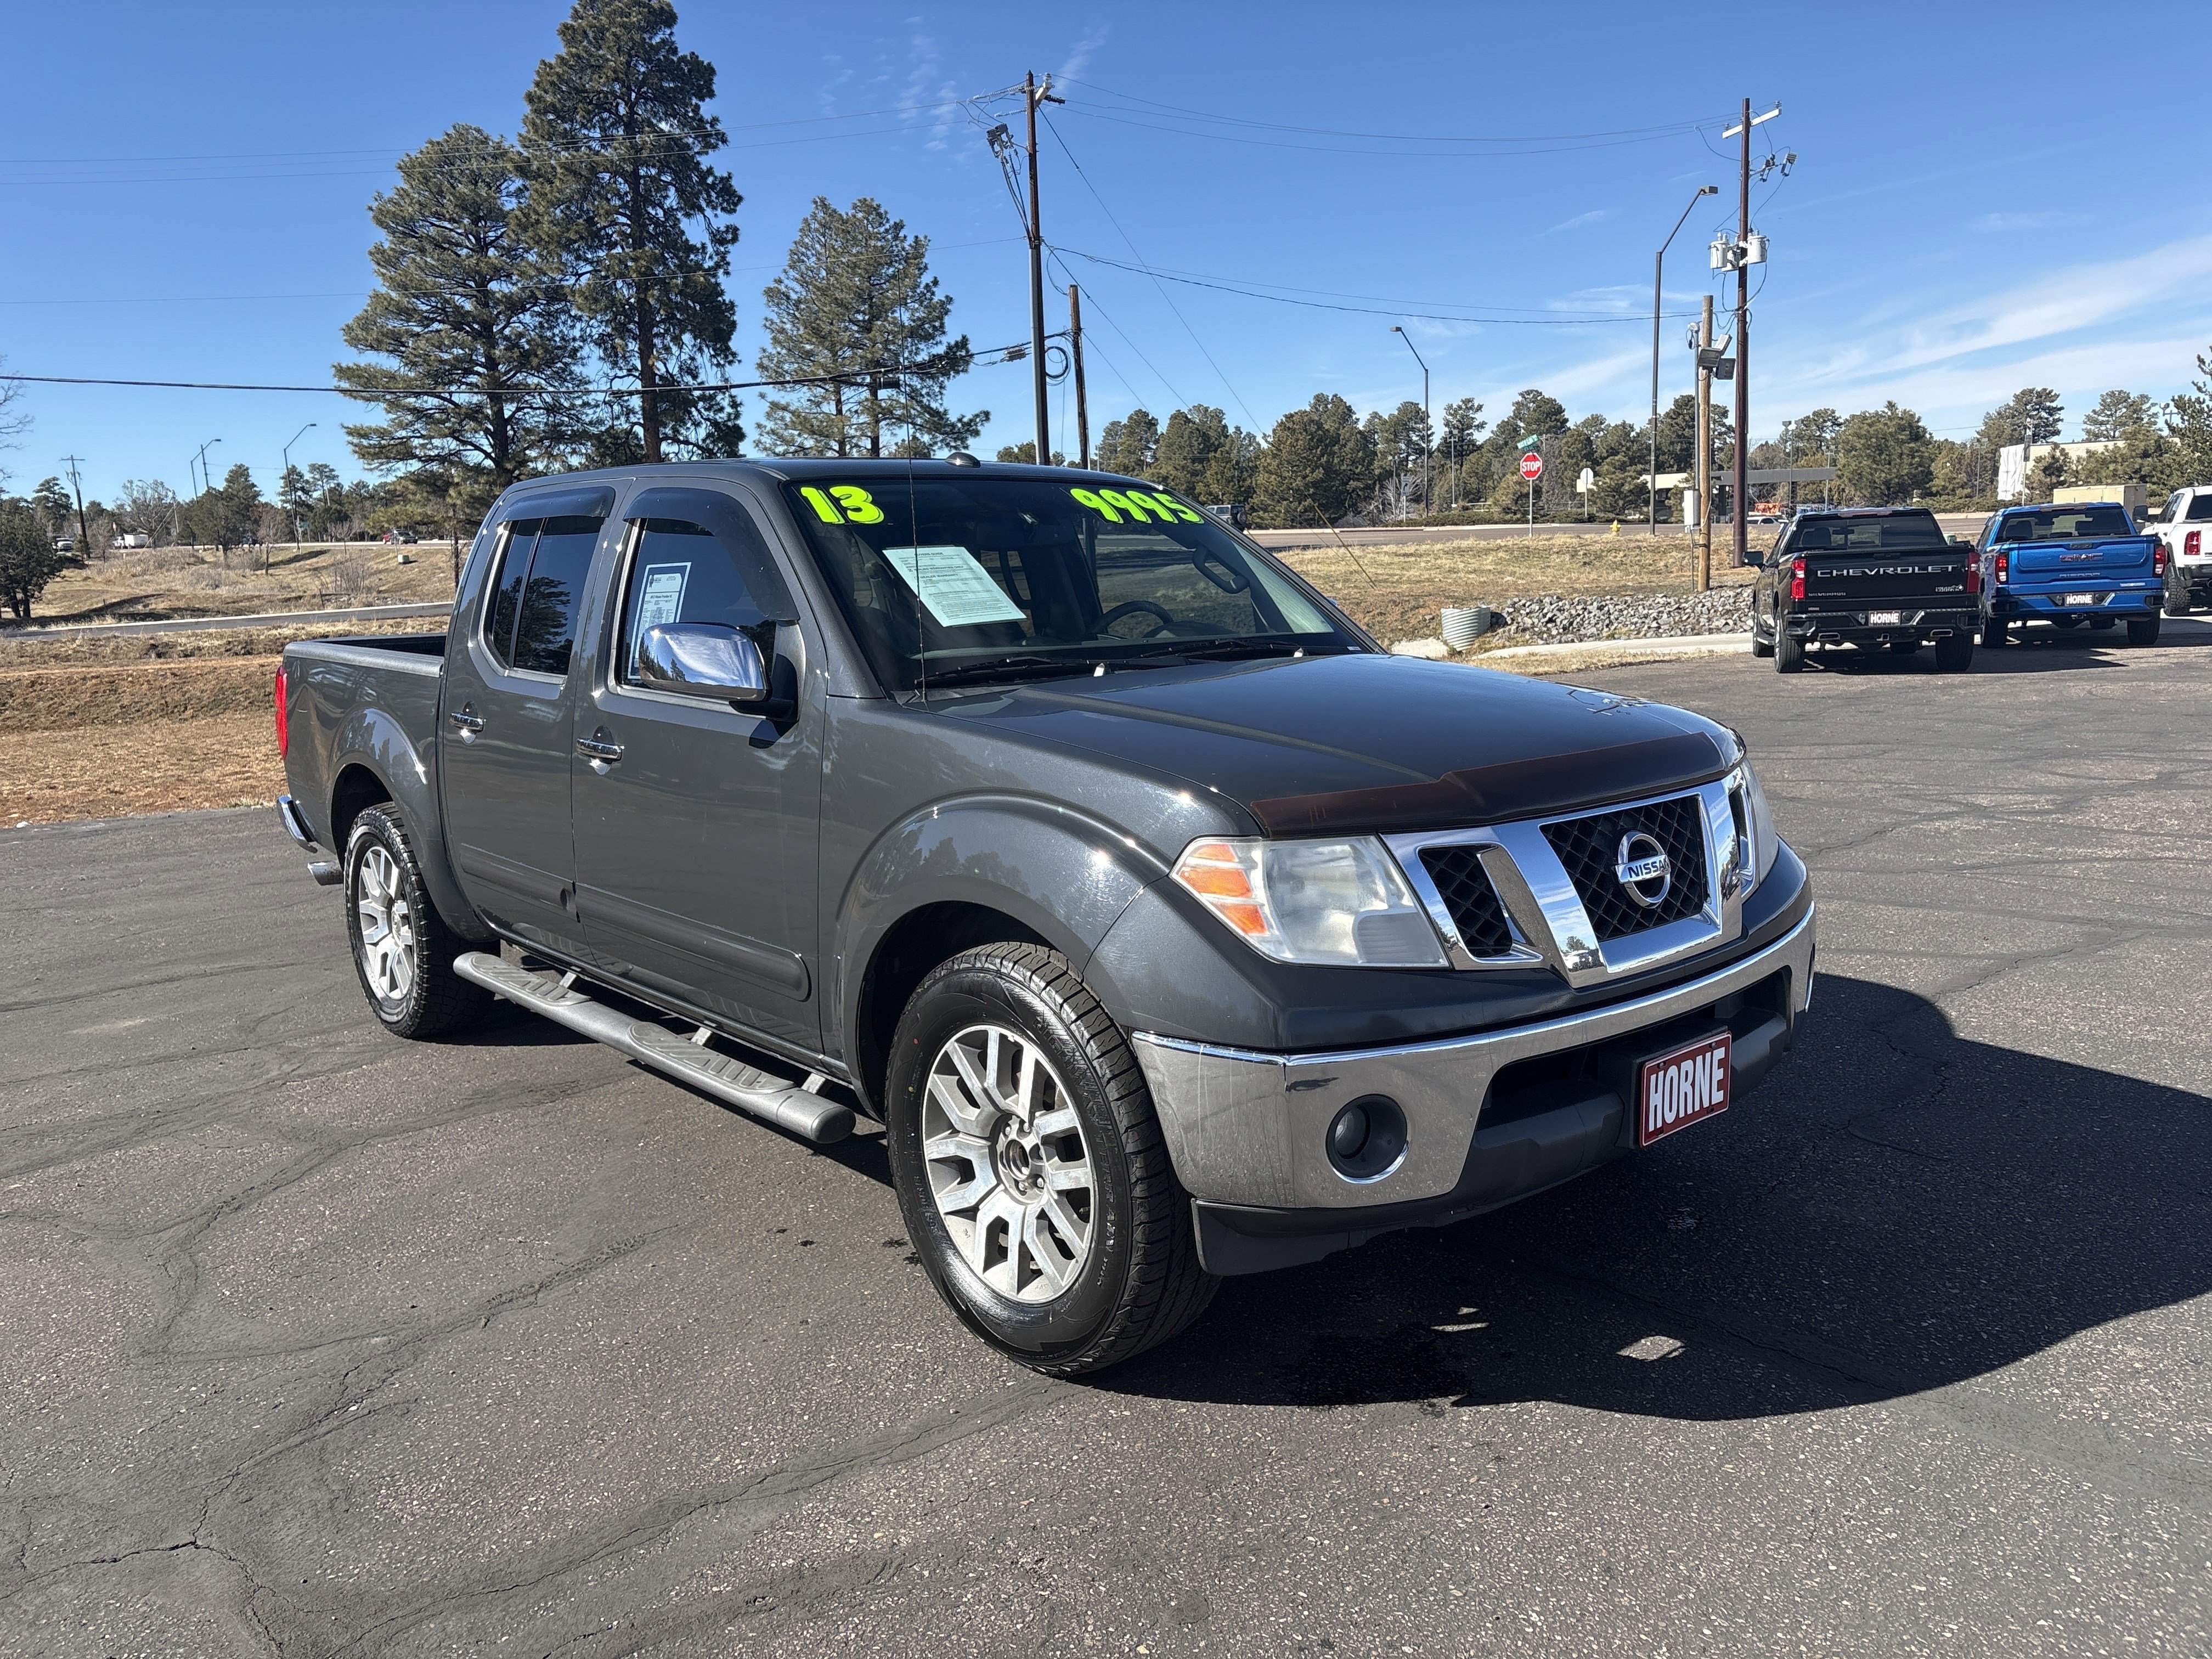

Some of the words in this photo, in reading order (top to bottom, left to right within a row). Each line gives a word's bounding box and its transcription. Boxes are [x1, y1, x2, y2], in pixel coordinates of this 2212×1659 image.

[1522, 461, 1541, 472] STOP
[800, 486, 884, 524] 13
[1070, 488, 1205, 524] 9995
[1817, 565, 1957, 578] CHEVROLET
[2067, 595, 2092, 605] HORNE
[1870, 613, 1899, 624] HORNE
[1627, 858, 1669, 878] NISSAN
[1648, 1046, 1725, 1133] HORNE
